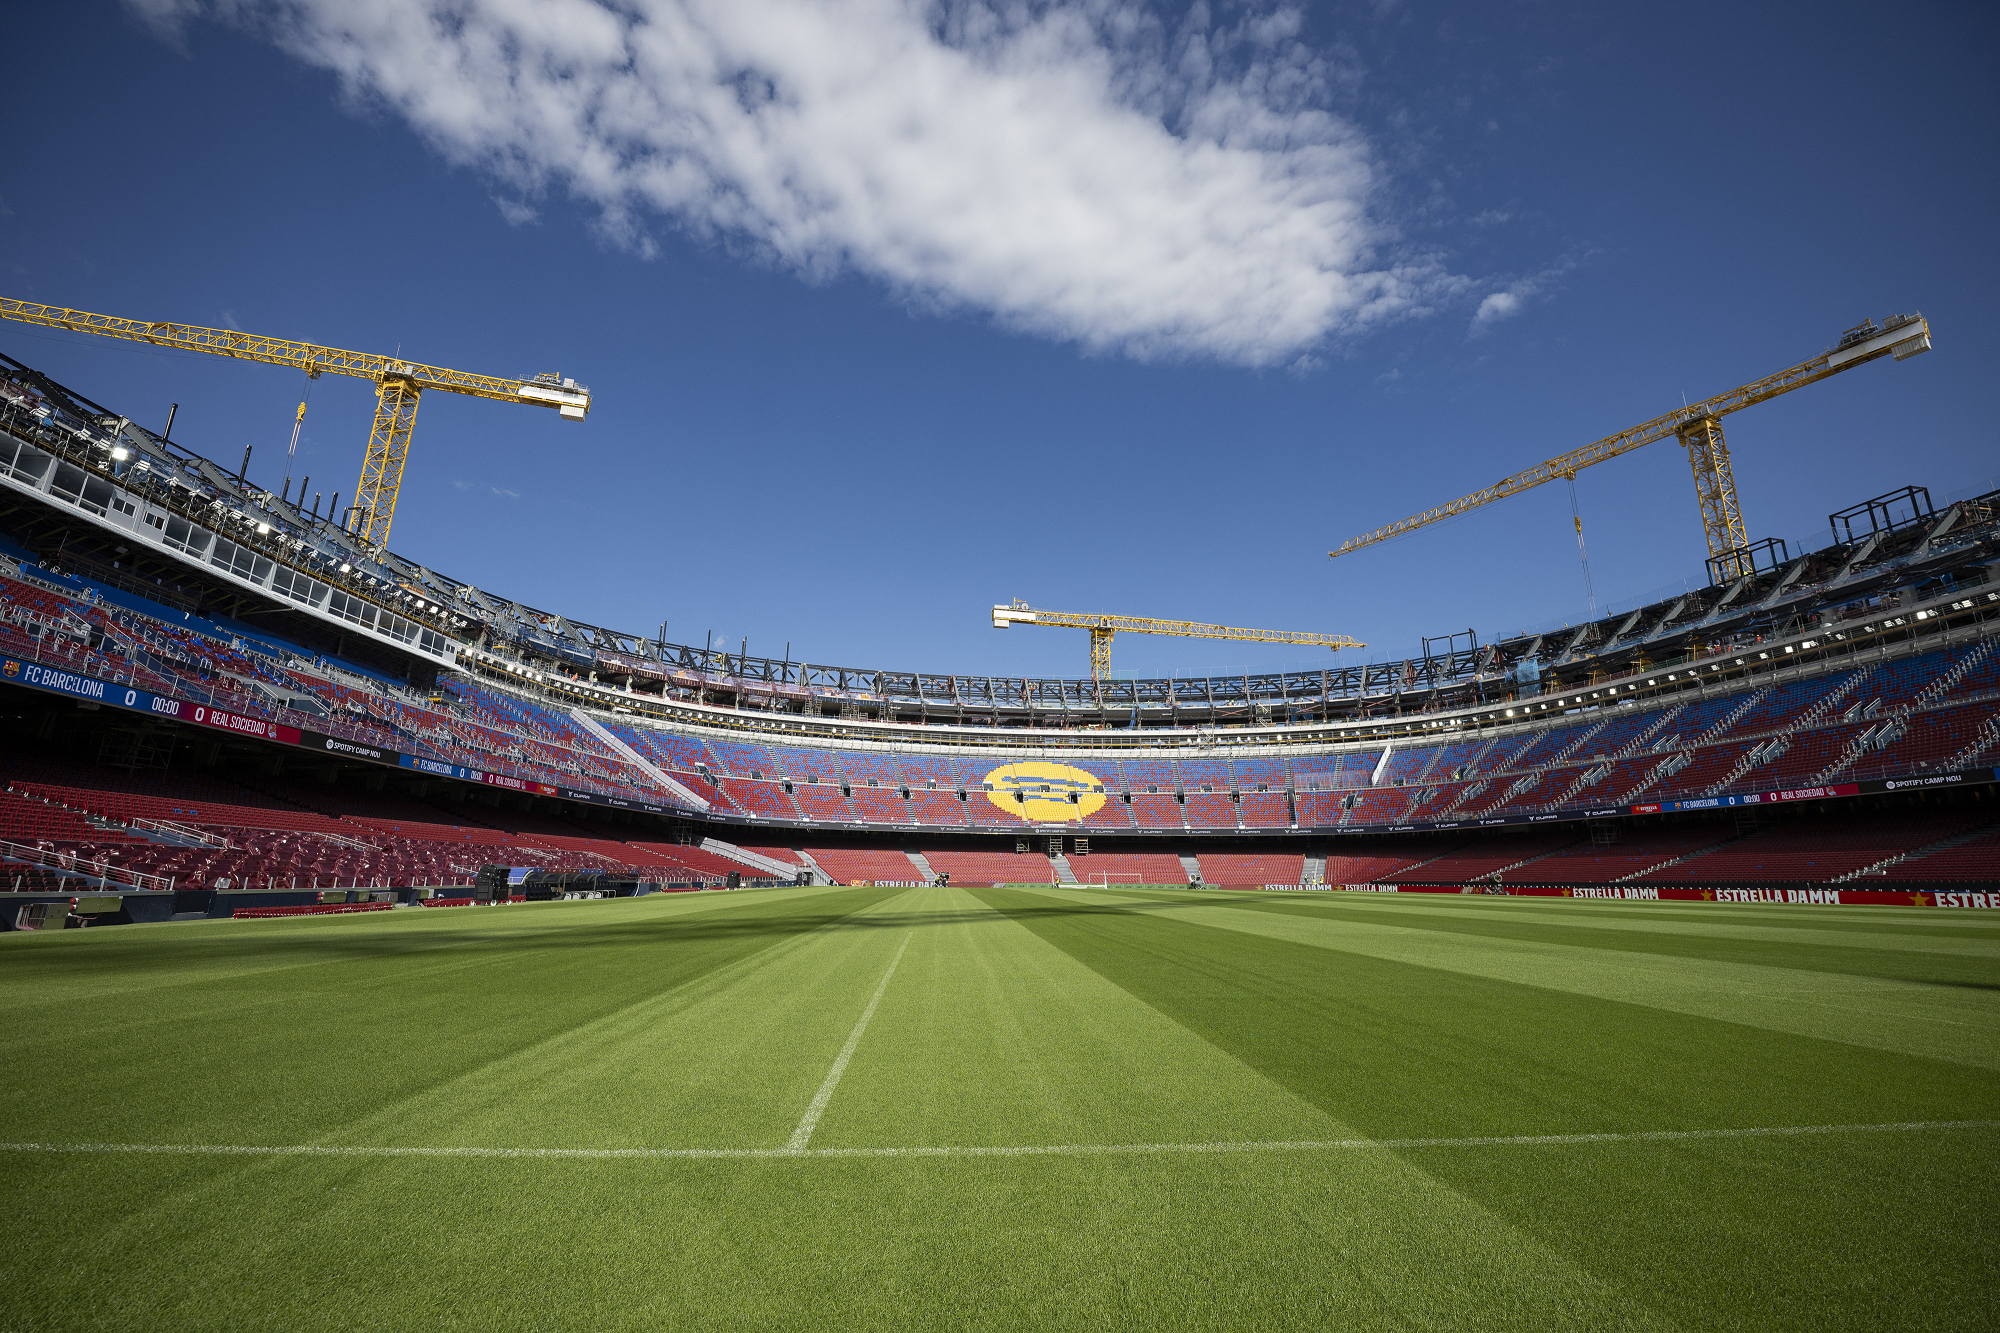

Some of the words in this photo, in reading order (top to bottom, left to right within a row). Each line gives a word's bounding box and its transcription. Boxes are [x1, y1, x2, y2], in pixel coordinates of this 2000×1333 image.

[24, 665, 41, 682] FC
[42, 669, 104, 698] BARCELONA
[124, 690, 137, 706] 0
[152, 696, 179, 715] 00:00
[195, 707, 205, 721] 0
[211, 711, 229, 727] REAL
[230, 715, 266, 735] SOCIEDAD
[334, 742, 355, 752] SPOTIFY
[355, 747, 370, 756] CAMP
[370, 750, 380, 758] NOU
[421, 760, 427, 769] FC
[460, 768, 465, 778] 0
[1896, 779, 1923, 788] SPOTIFY
[1924, 777, 1945, 785] CAMP
[1945, 774, 1961, 782] NOU
[1743, 795, 1760, 803] 00:00
[1770, 792, 1777, 801] 0
[1781, 790, 1795, 800] REAL
[1797, 788, 1825, 799] SOCIEDAD
[1683, 801, 1690, 809] FC
[1690, 799, 1719, 808] BARCELONA
[1728, 797, 1735, 805] 0
[1346, 884, 1376, 892] ESTRELLA
[1573, 888, 1621, 898] ESTRELLA
[1624, 888, 1659, 900] DAMM
[1716, 889, 1784, 902] ESTRELLA
[1787, 890, 1840, 904] DAMM
[1934, 892, 2000, 908] ESTRE
